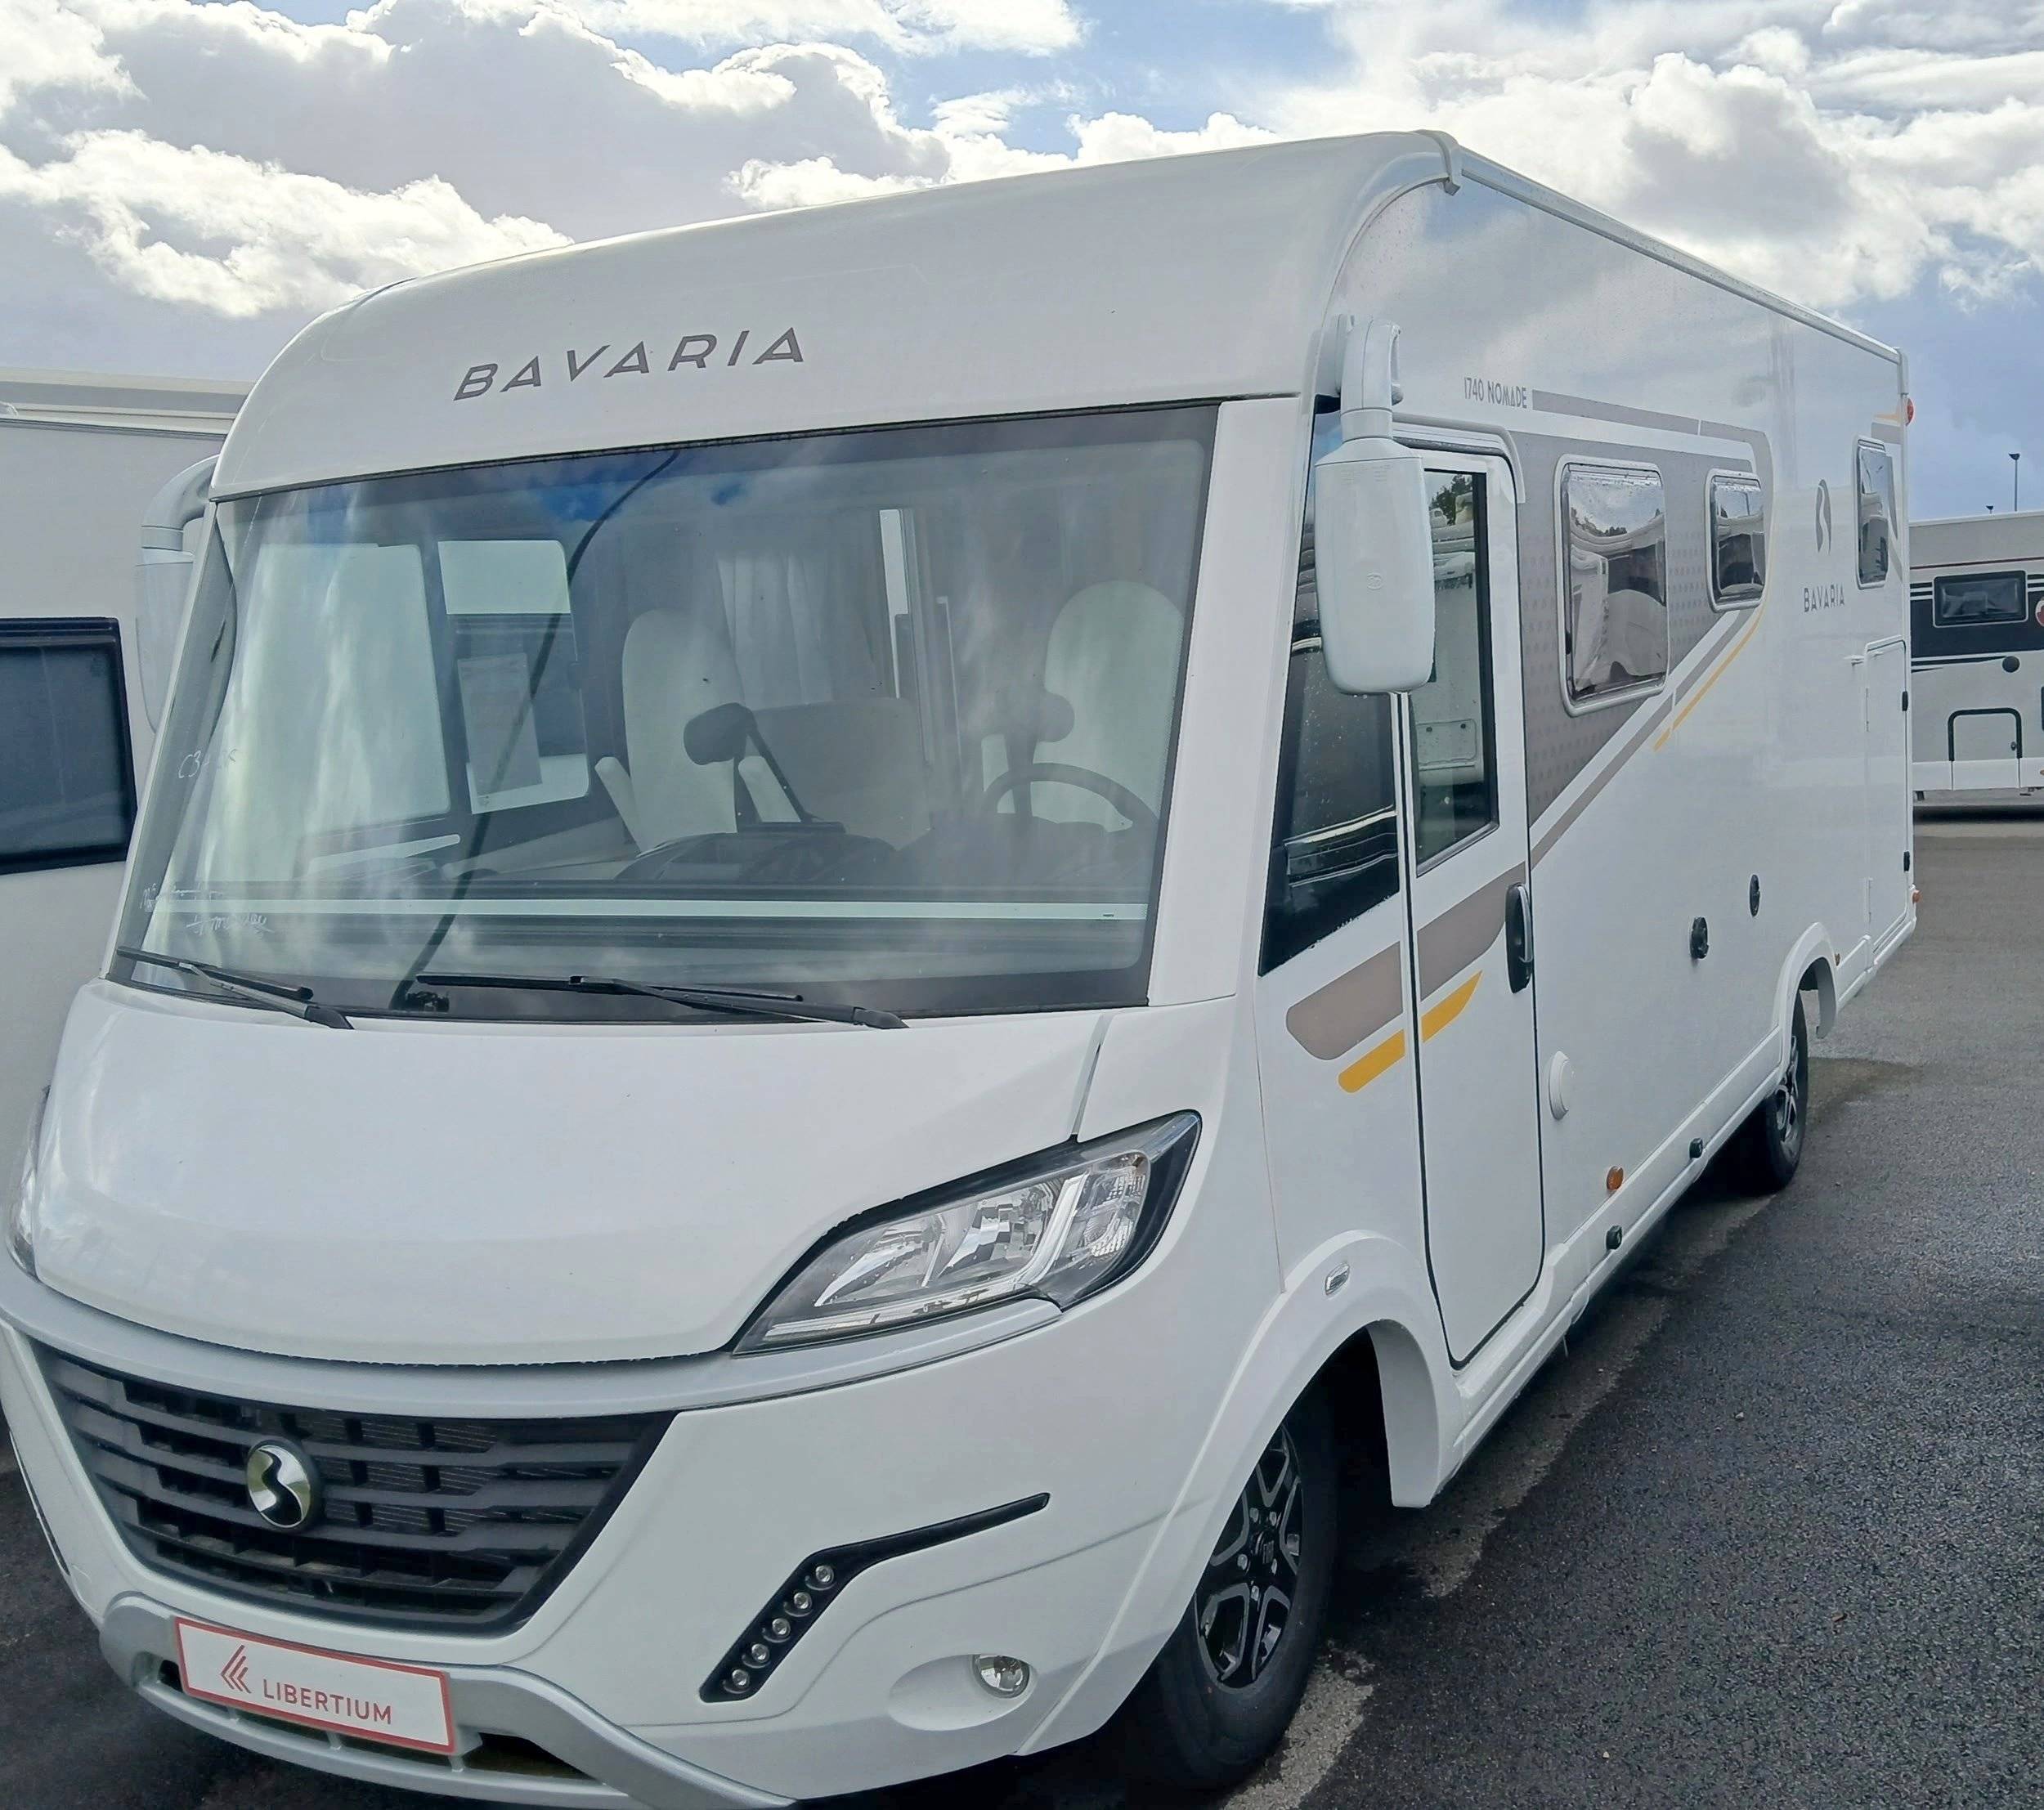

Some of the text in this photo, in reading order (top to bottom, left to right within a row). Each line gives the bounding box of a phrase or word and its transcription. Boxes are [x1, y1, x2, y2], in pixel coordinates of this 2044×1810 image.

[454, 327, 804, 401] BAVARIA
[1487, 380, 1527, 409] NOMADE
[1803, 583, 1845, 612] BAVARIA
[262, 1678, 392, 1725] LIBERTIUM
